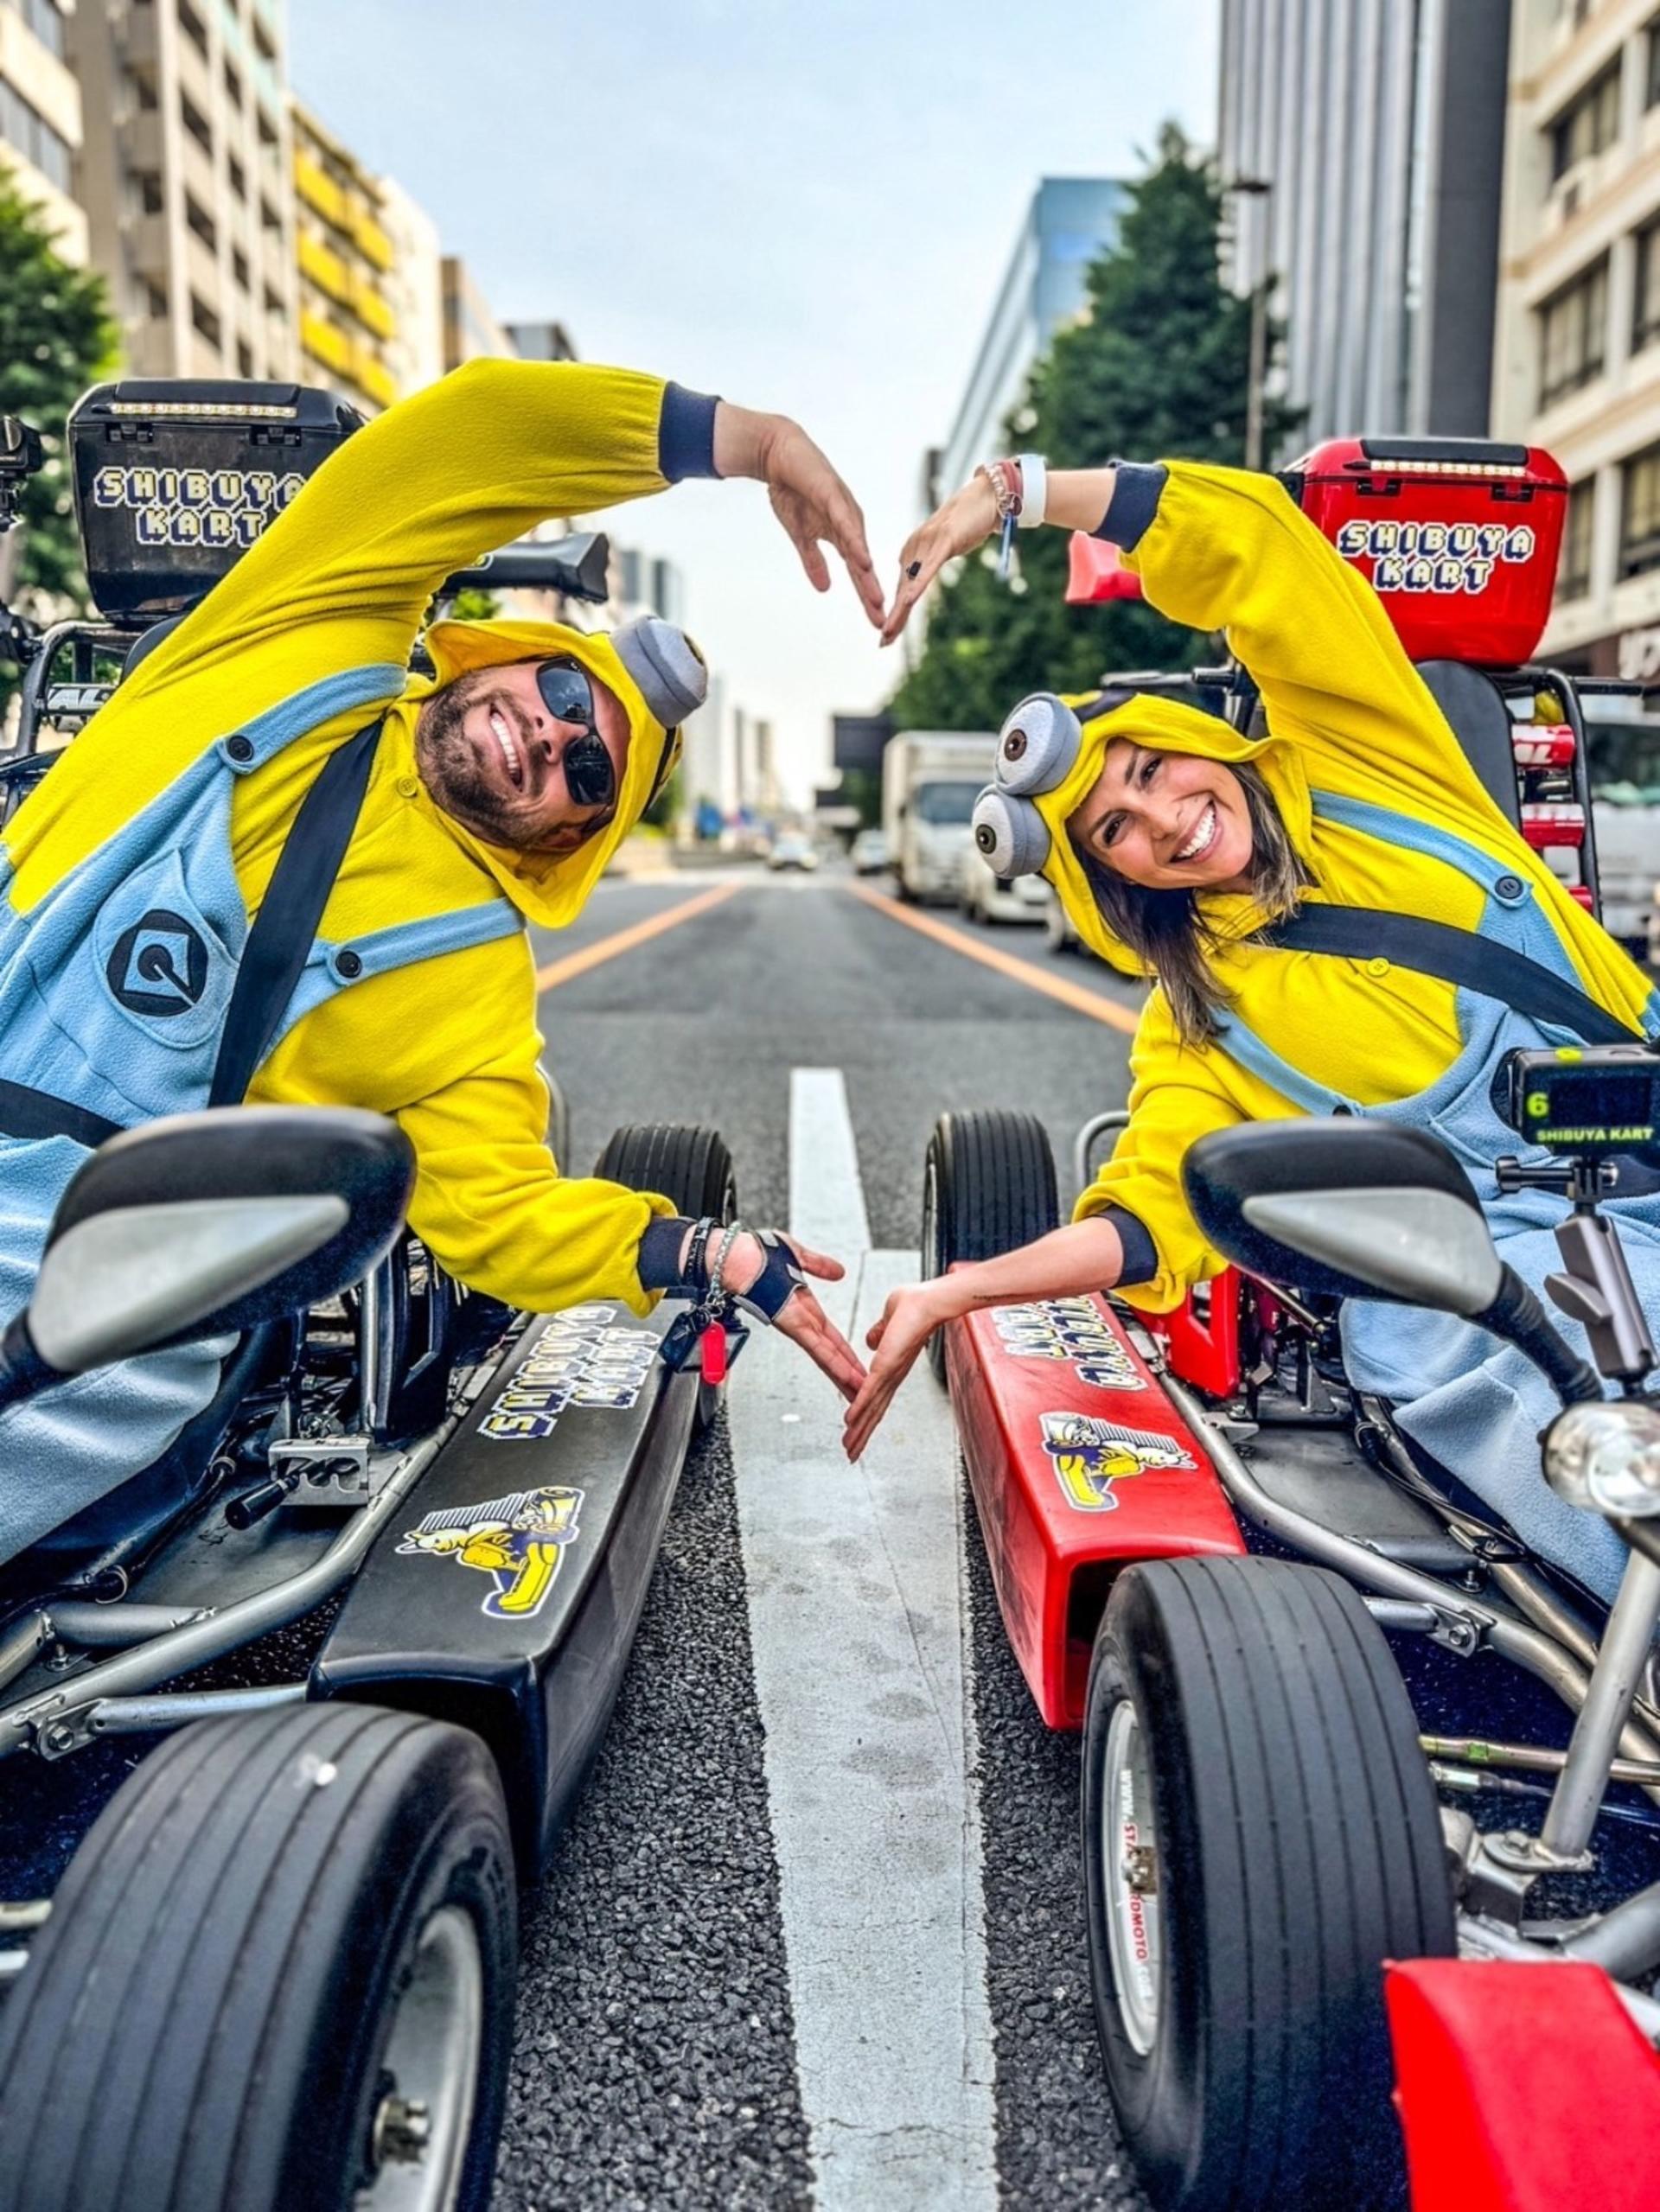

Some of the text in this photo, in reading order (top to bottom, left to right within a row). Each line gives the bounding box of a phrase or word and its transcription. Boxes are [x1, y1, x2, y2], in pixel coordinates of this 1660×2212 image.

[94, 466, 306, 512] SHIBUYA
[136, 506, 266, 547] KART
[1338, 520, 1536, 563] SHIBUYA
[1373, 557, 1495, 595] KART
[1527, 1092, 1549, 1118] 6
[1536, 1127, 1654, 1142] SHIBUYA KART
[990, 1300, 1073, 1361] ART
[476, 1305, 617, 1439] SHIBUYA
[568, 1327, 662, 1409] KART
